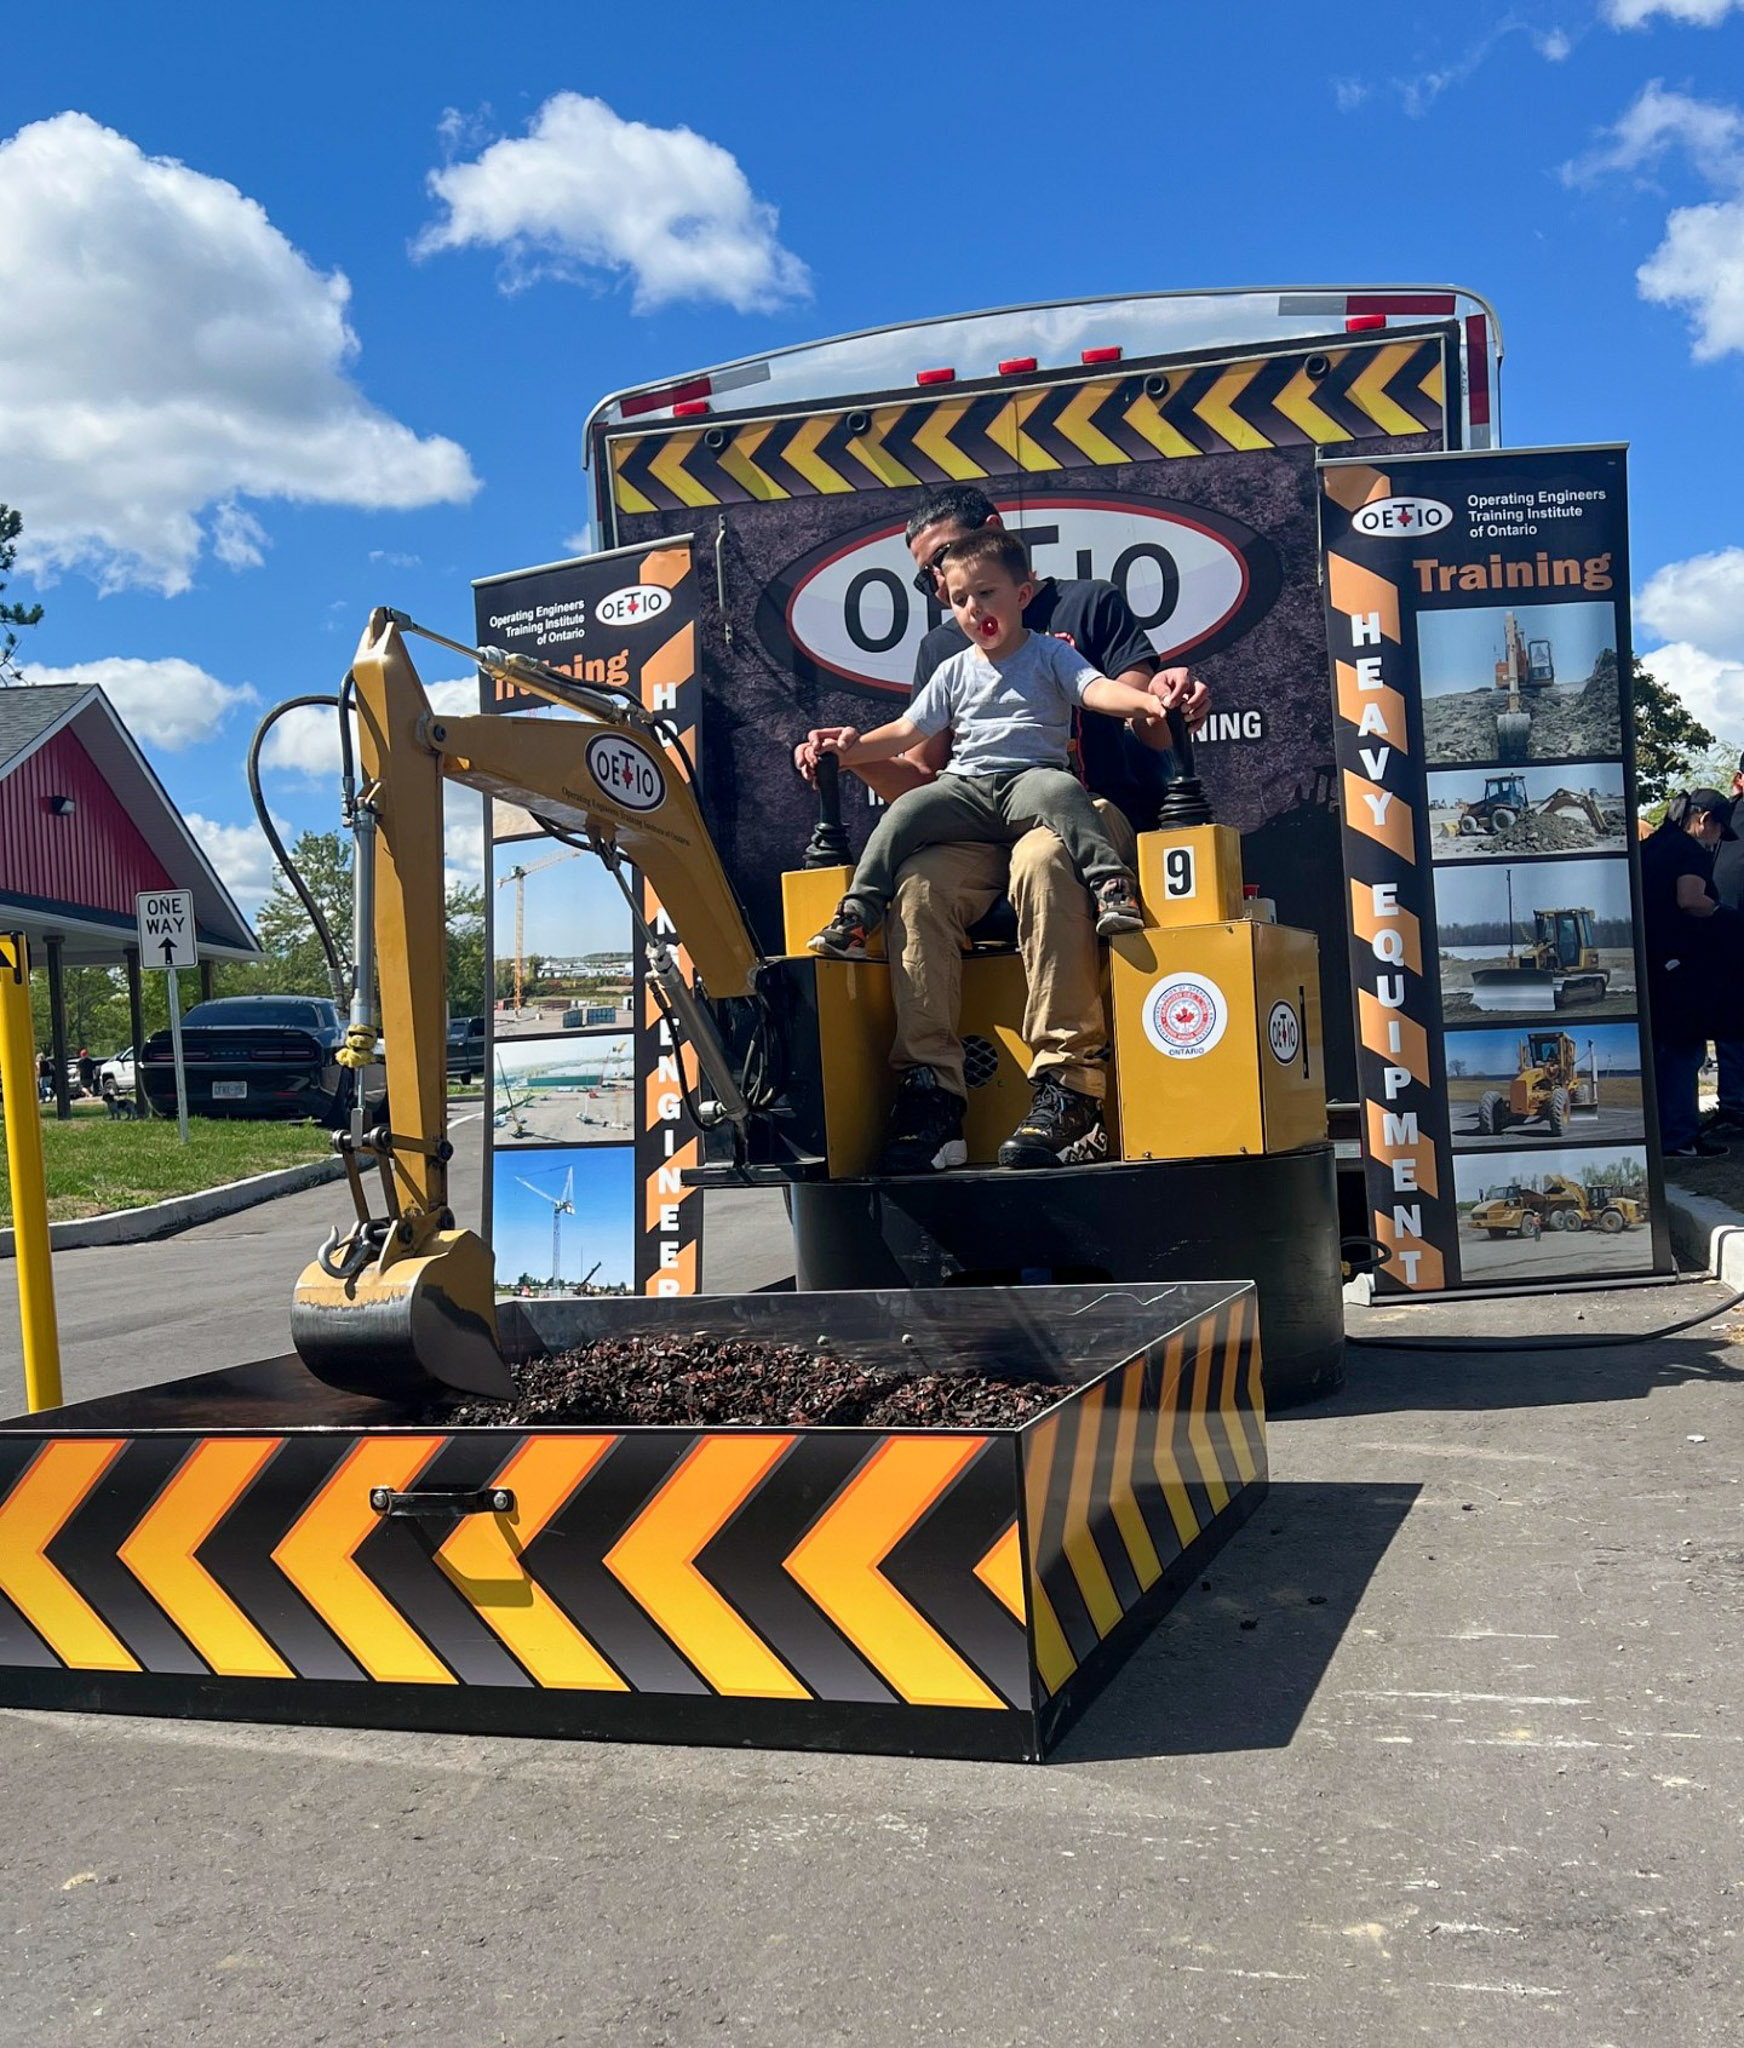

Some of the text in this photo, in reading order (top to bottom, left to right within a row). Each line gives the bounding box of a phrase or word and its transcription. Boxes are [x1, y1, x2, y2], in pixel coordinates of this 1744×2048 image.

[1468, 490, 1606, 508] Operating Engineers
[1362, 504, 1443, 530] OETIO
[1469, 505, 1583, 523] Training Institute
[1469, 524, 1538, 538] of Ontario
[1413, 552, 1613, 592] Training
[489, 600, 585, 629] Operating Engineers
[602, 592, 662, 620] OETIO
[505, 614, 585, 638] Training Institute
[536, 628, 585, 645] of Ontario
[1350, 612, 1393, 826] HEAVY
[1166, 849, 1192, 896] 9
[147, 897, 182, 915] ONE
[146, 917, 185, 935] WAY
[1169, 1047, 1205, 1056] ONTARIO
[1371, 883, 1422, 1285] EQUIPMENT
